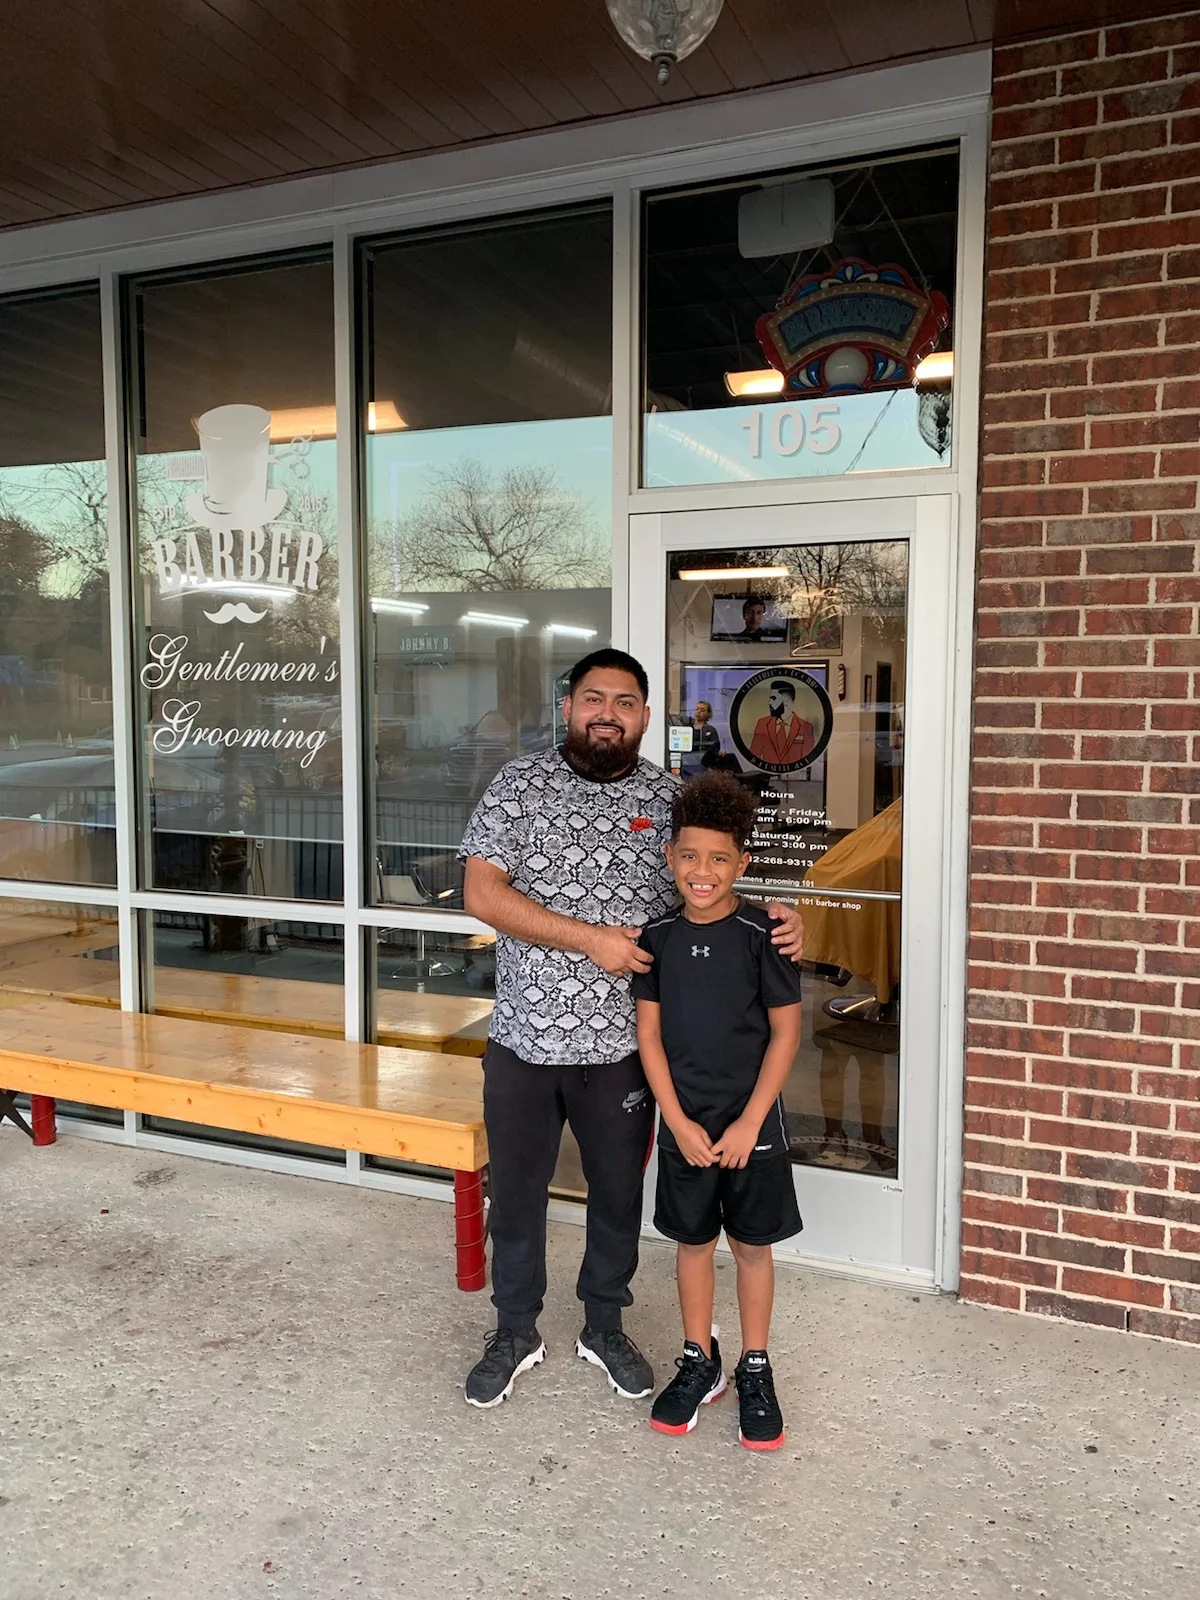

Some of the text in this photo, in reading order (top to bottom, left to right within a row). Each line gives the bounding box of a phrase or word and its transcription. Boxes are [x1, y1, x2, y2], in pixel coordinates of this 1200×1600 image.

[740, 404, 841, 459] 105
[151, 527, 323, 594] BARBER
[400, 637, 439, 651] JOHNNY
[140, 633, 339, 690] Gentlemen's
[153, 698, 328, 769] Grooming
[760, 791, 795, 799] Hours
[755, 807, 777, 816] day
[789, 808, 825, 818] Friday
[785, 817, 810, 825] 6:00
[813, 818, 832, 826] pm
[752, 831, 802, 842] Saturday
[782, 841, 806, 849] 3:00
[749, 855, 814, 867] 12-268-9313
[764, 878, 799, 888] grooming
[764, 895, 799, 905] grooming
[815, 899, 841, 908] barber
[842, 902, 861, 911] shop
